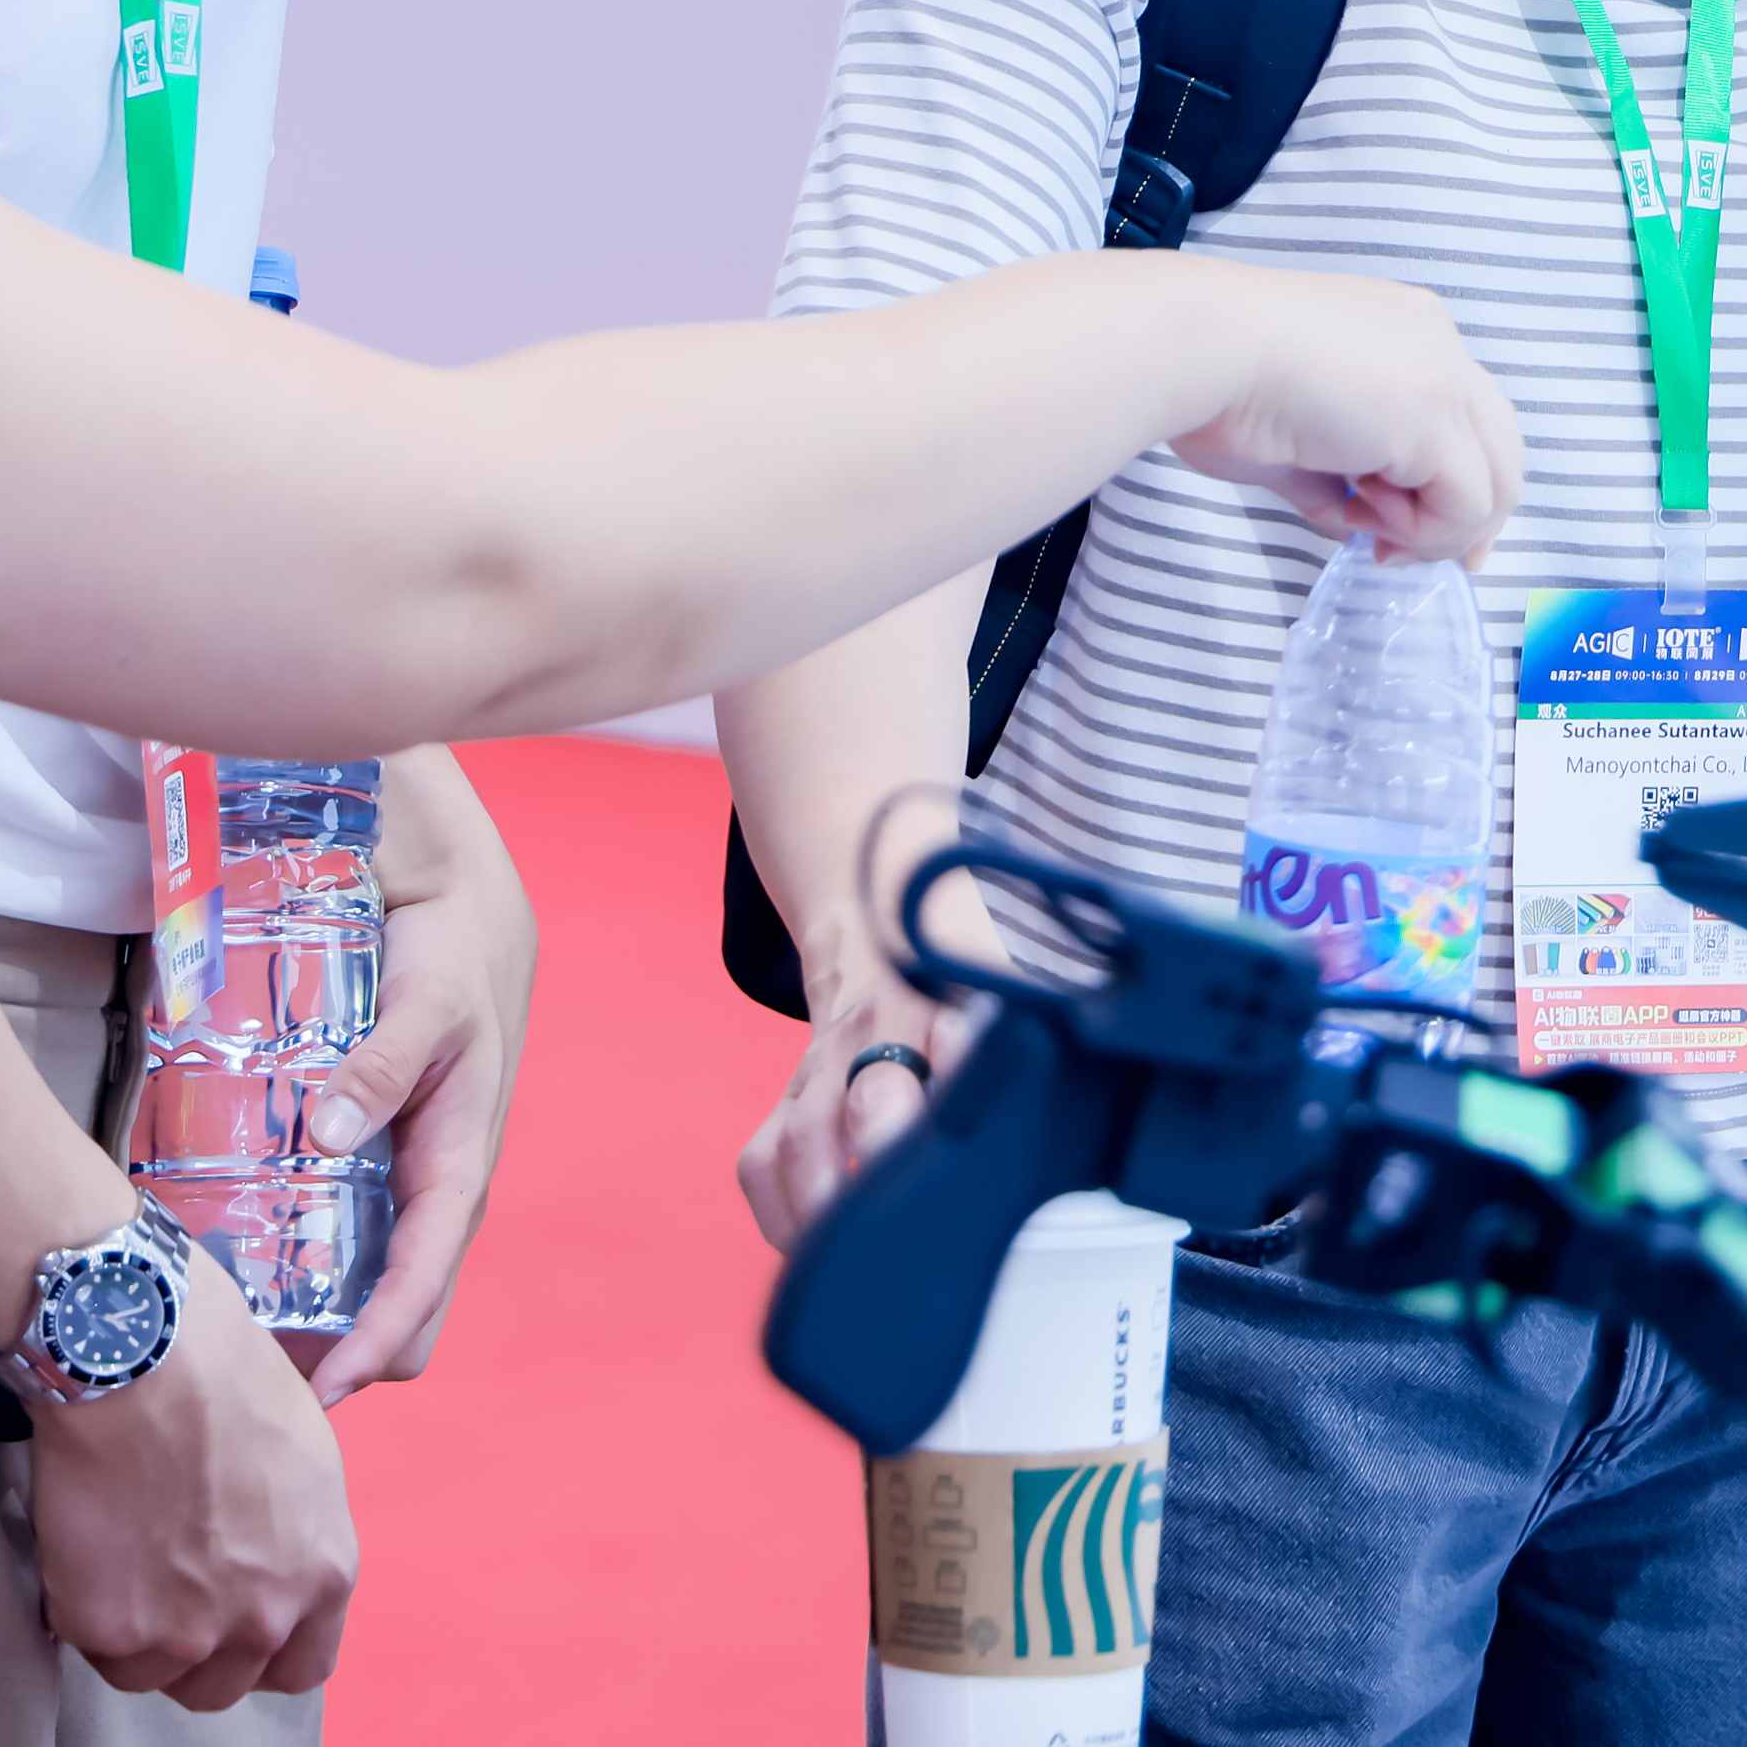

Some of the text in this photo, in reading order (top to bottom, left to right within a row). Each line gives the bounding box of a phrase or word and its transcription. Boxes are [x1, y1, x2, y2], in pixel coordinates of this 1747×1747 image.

[1572, 626, 1634, 661] AGIC
[1615, 670, 1679, 681] 09:00-16:30
[1537, 703, 1567, 719] 观众
[1563, 722, 1651, 739] Suchanee
[1566, 756, 1696, 778] Manoyontchai
[1703, 755, 1735, 776] Co.,
[1111, 1308, 1131, 1441] RBUCKS
